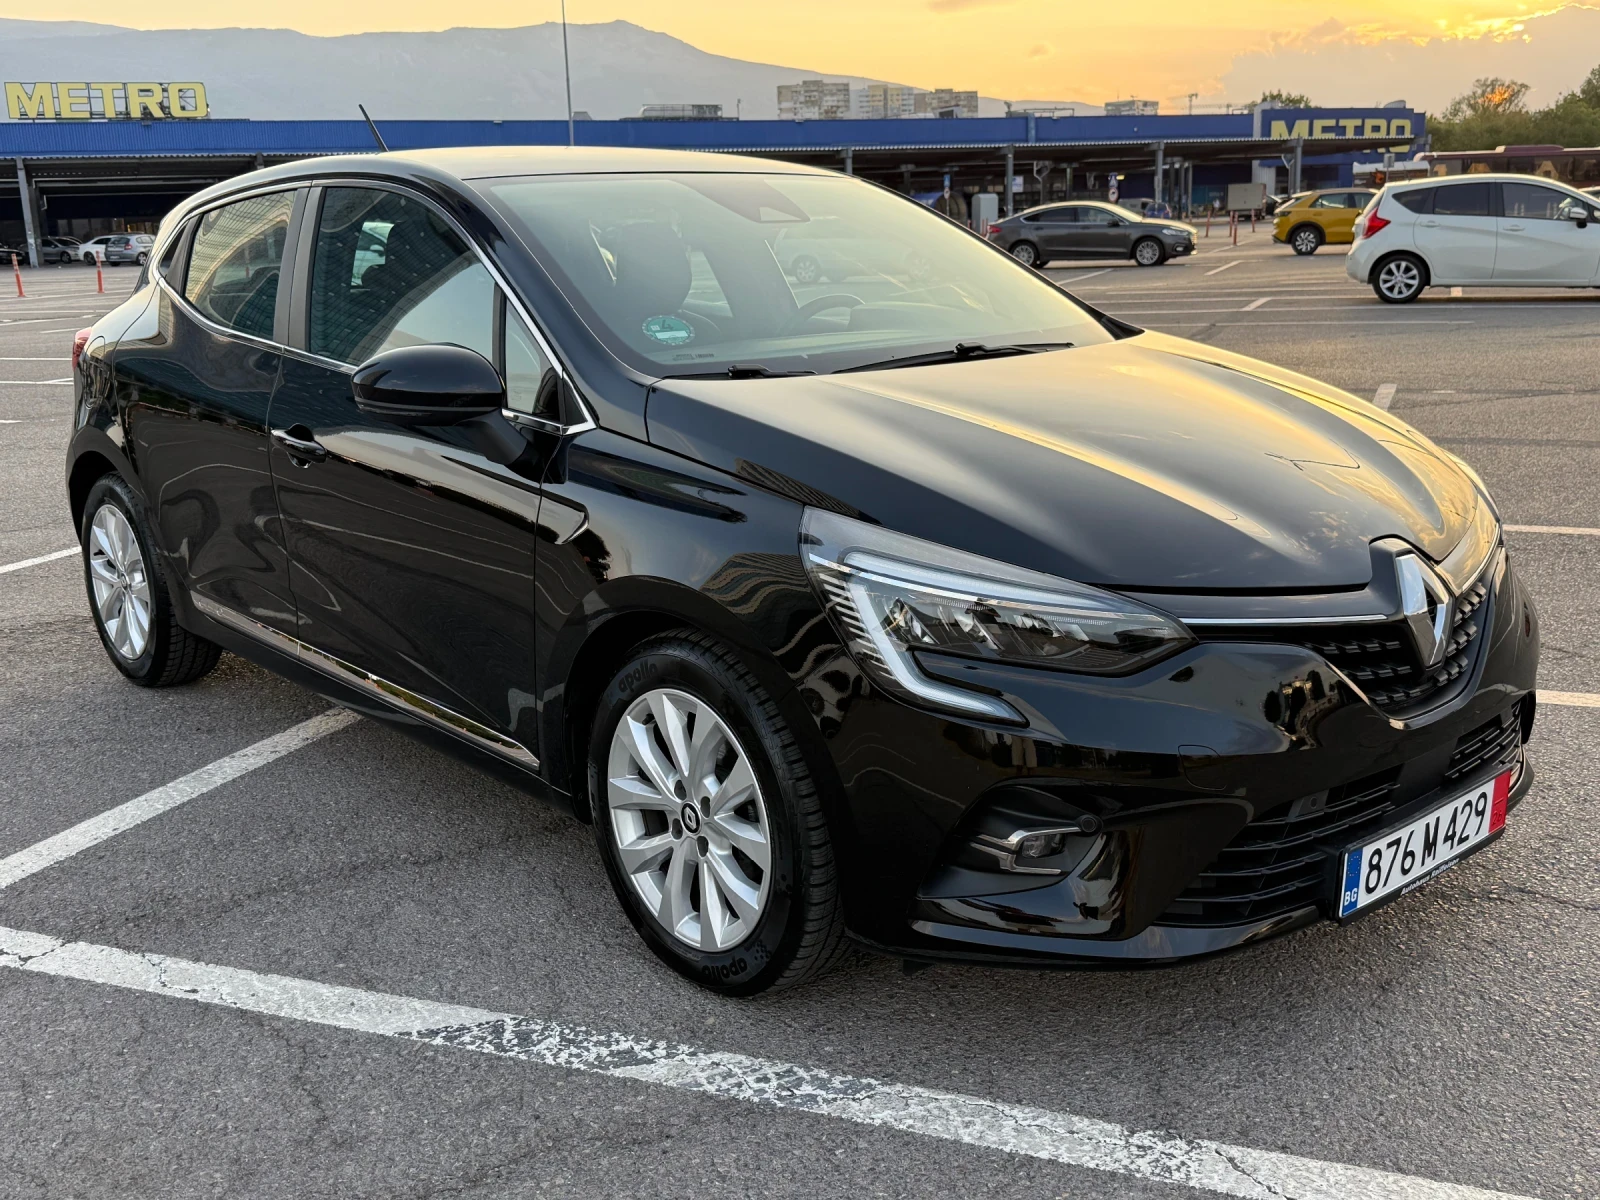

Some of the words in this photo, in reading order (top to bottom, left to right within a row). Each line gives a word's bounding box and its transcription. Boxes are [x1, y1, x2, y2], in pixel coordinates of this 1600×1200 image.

[4, 82, 208, 119] METRO
[1270, 118, 1411, 153] METRO
[618, 658, 658, 692] apollo
[1344, 888, 1358, 905] BG
[1400, 875, 1430, 895] Autohaus
[701, 955, 748, 980] apollo
